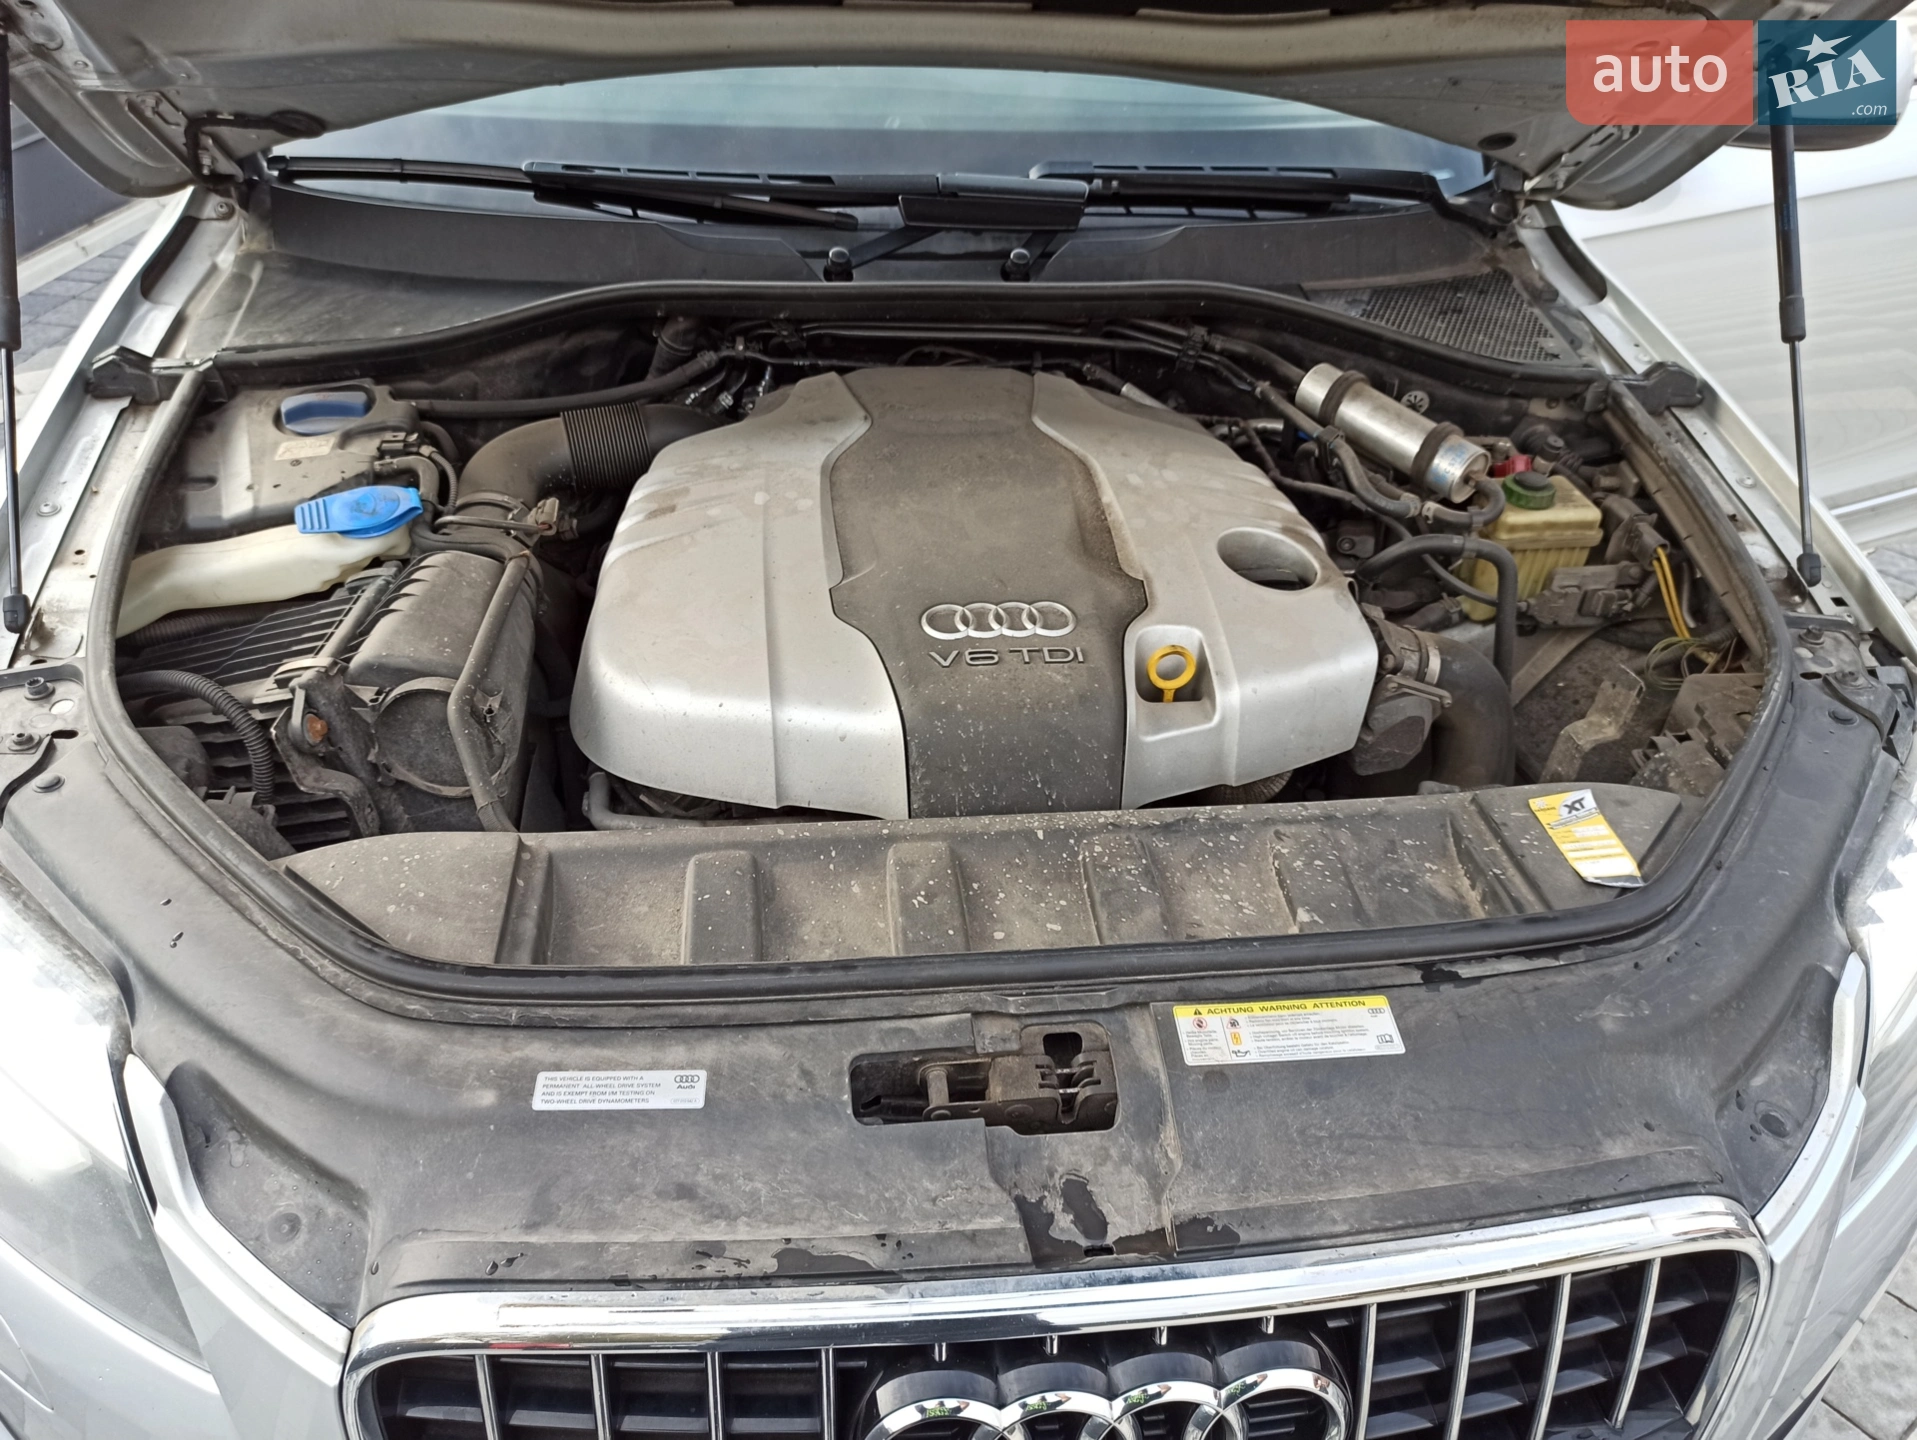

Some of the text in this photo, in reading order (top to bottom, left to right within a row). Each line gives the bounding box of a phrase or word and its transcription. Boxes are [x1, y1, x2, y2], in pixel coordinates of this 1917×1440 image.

[928, 645, 1085, 668] V6 TDI
[1563, 796, 1586, 815] XT
[1206, 1000, 1367, 1015] ACHTUNG WARNING ATTENTION
